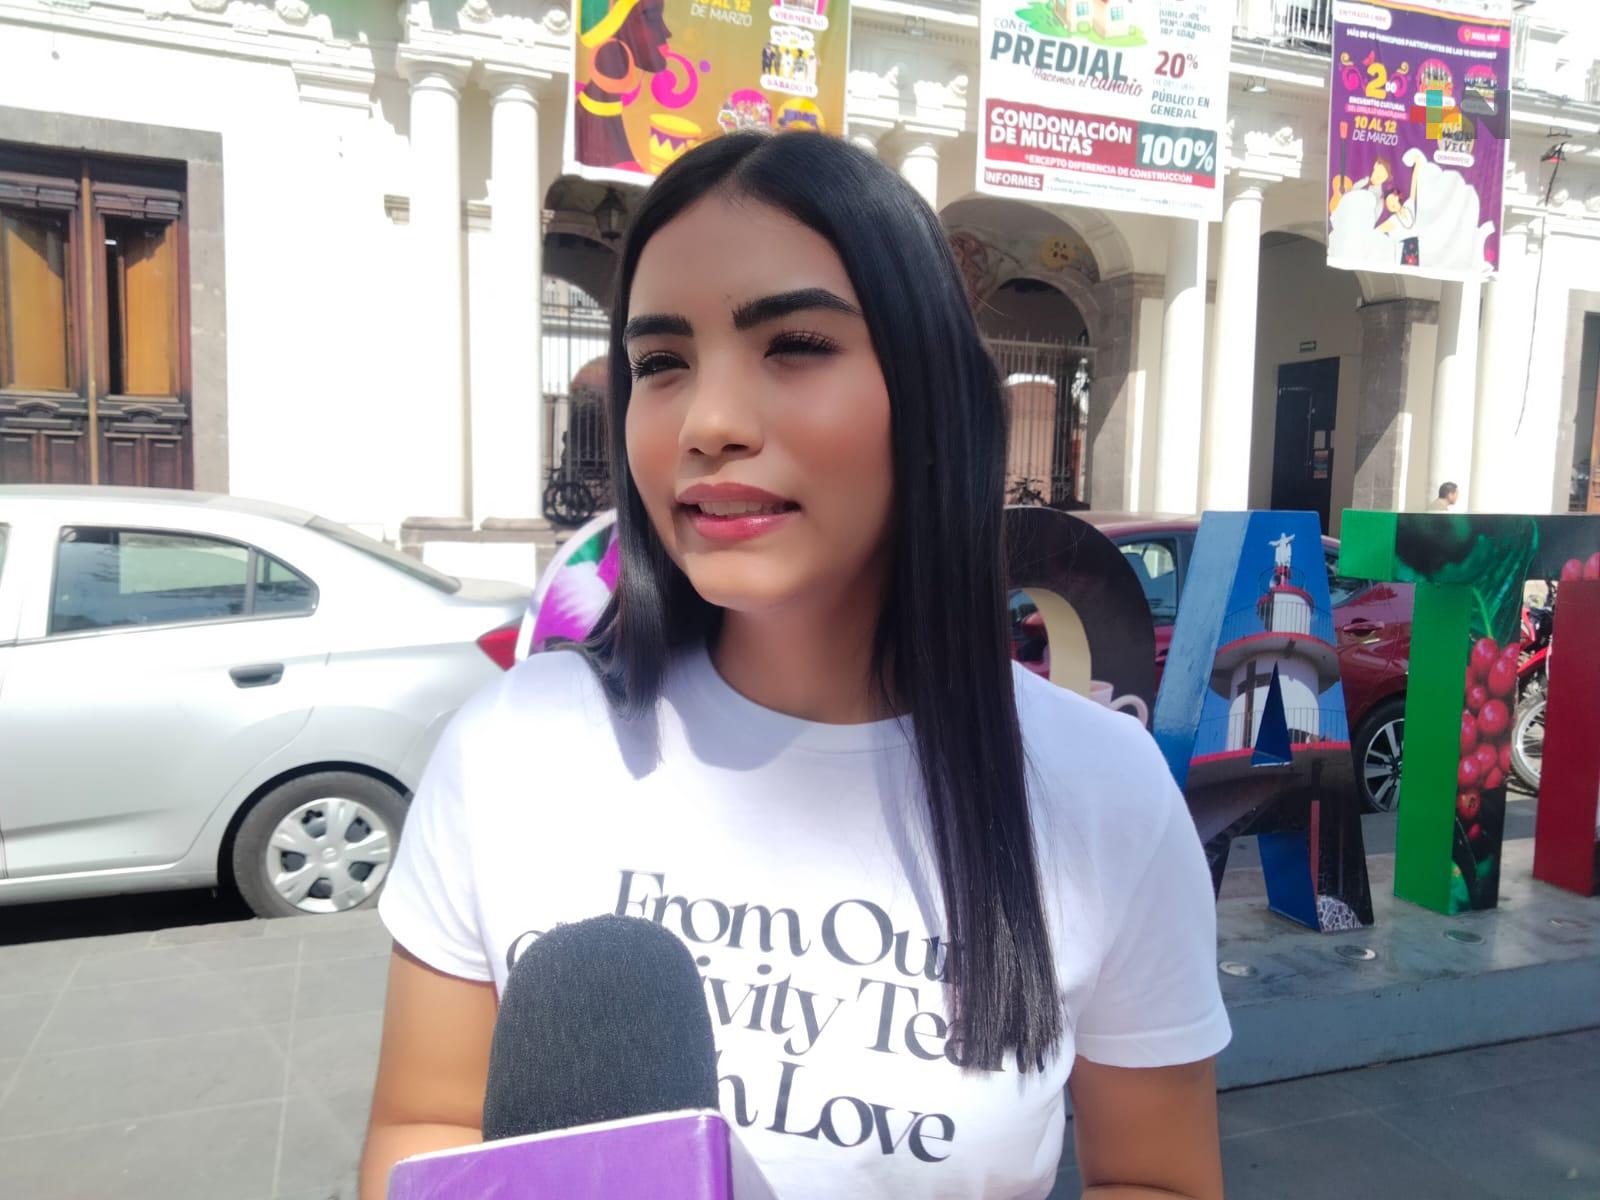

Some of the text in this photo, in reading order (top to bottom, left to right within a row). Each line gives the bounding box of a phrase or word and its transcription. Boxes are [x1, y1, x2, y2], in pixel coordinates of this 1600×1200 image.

[691, 3, 753, 27] DE MARZO
[990, 30, 1129, 83] PREDIAL
[1154, 50, 1199, 79] 20%
[1150, 103, 1198, 119] GENERAL
[1152, 88, 1211, 108] PÚBLICO EN
[991, 107, 1132, 144] CONDONACIÓN
[1352, 129, 1398, 146] DE MARZO
[1354, 115, 1397, 133] 10 AL 12
[990, 125, 1093, 156] DE MULTAS
[1141, 134, 1214, 172] 100%
[985, 170, 1041, 188] INFORMES
[1068, 159, 1116, 175] DIFERENCIA
[1117, 166, 1129, 177] DE
[1130, 167, 1193, 184] CONSTRUCCIÓN
[615, 869, 811, 957] From
[765, 1061, 956, 1163] Love
